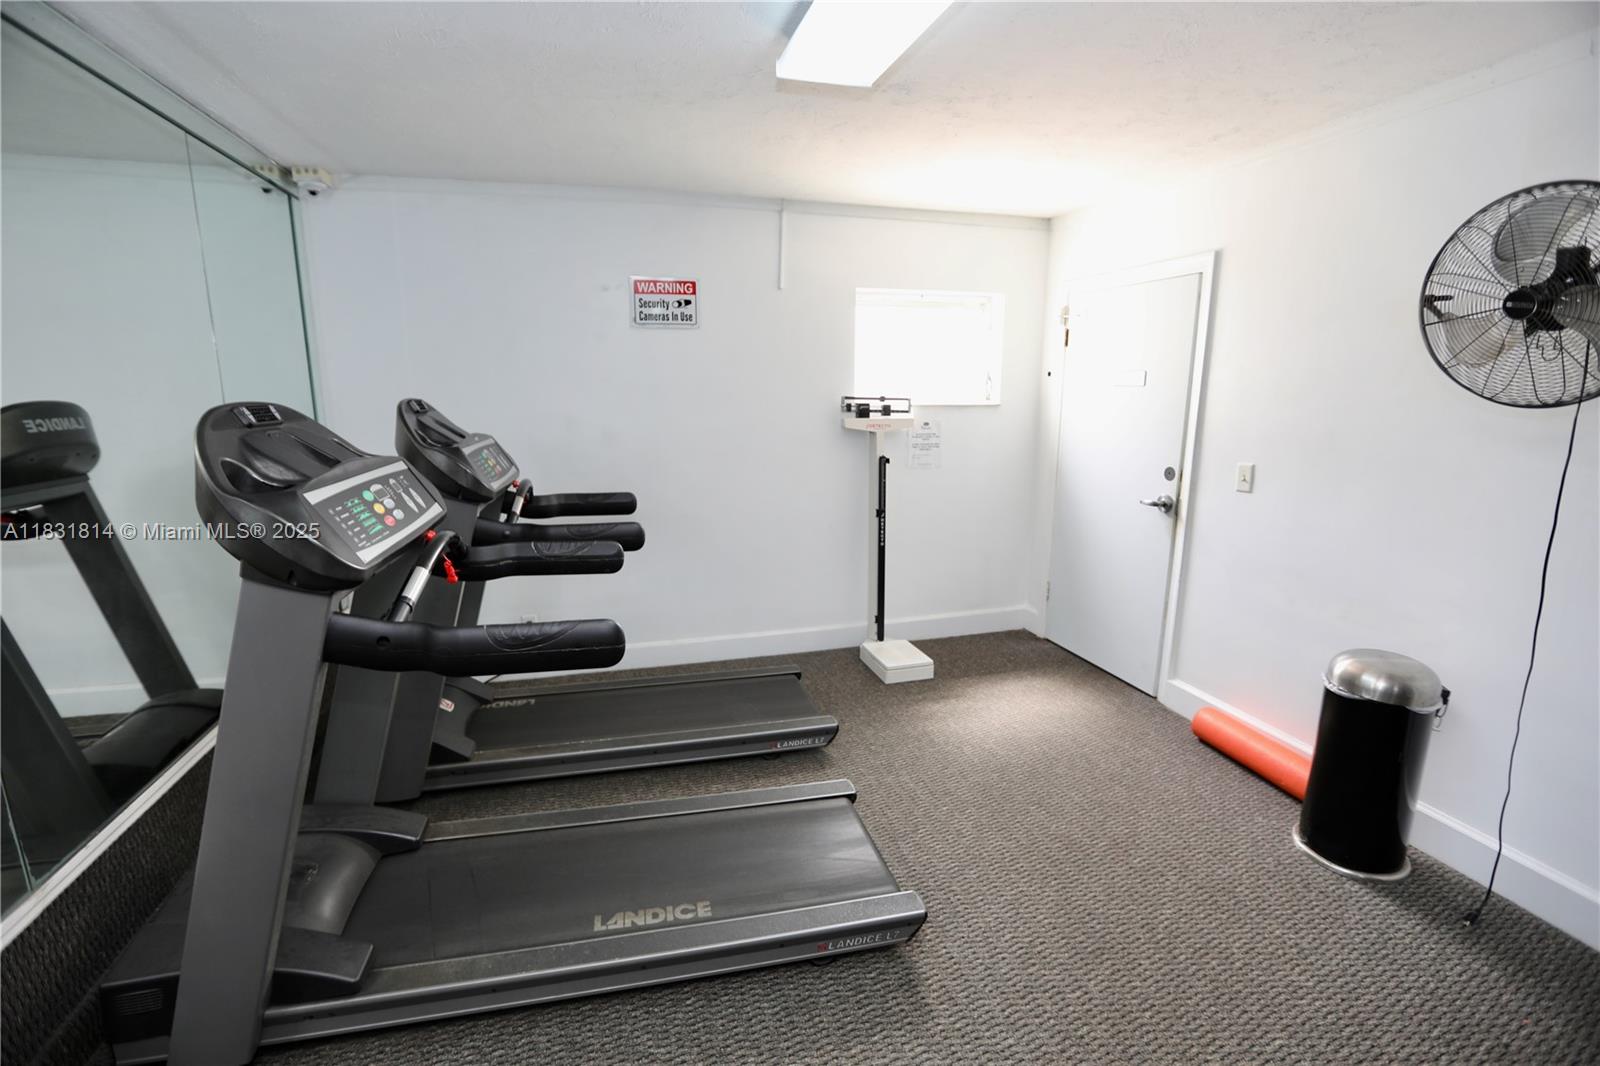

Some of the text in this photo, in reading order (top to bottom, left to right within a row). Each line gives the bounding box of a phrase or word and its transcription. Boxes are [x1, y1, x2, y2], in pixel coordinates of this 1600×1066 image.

[636, 282, 693, 294] WARNING
[638, 298, 670, 310] Security
[639, 311, 693, 321] Cameras In Use
[776, 737, 813, 748] LANDICE
[593, 900, 713, 932] LANDICE
[828, 934, 883, 950] LANDICE
